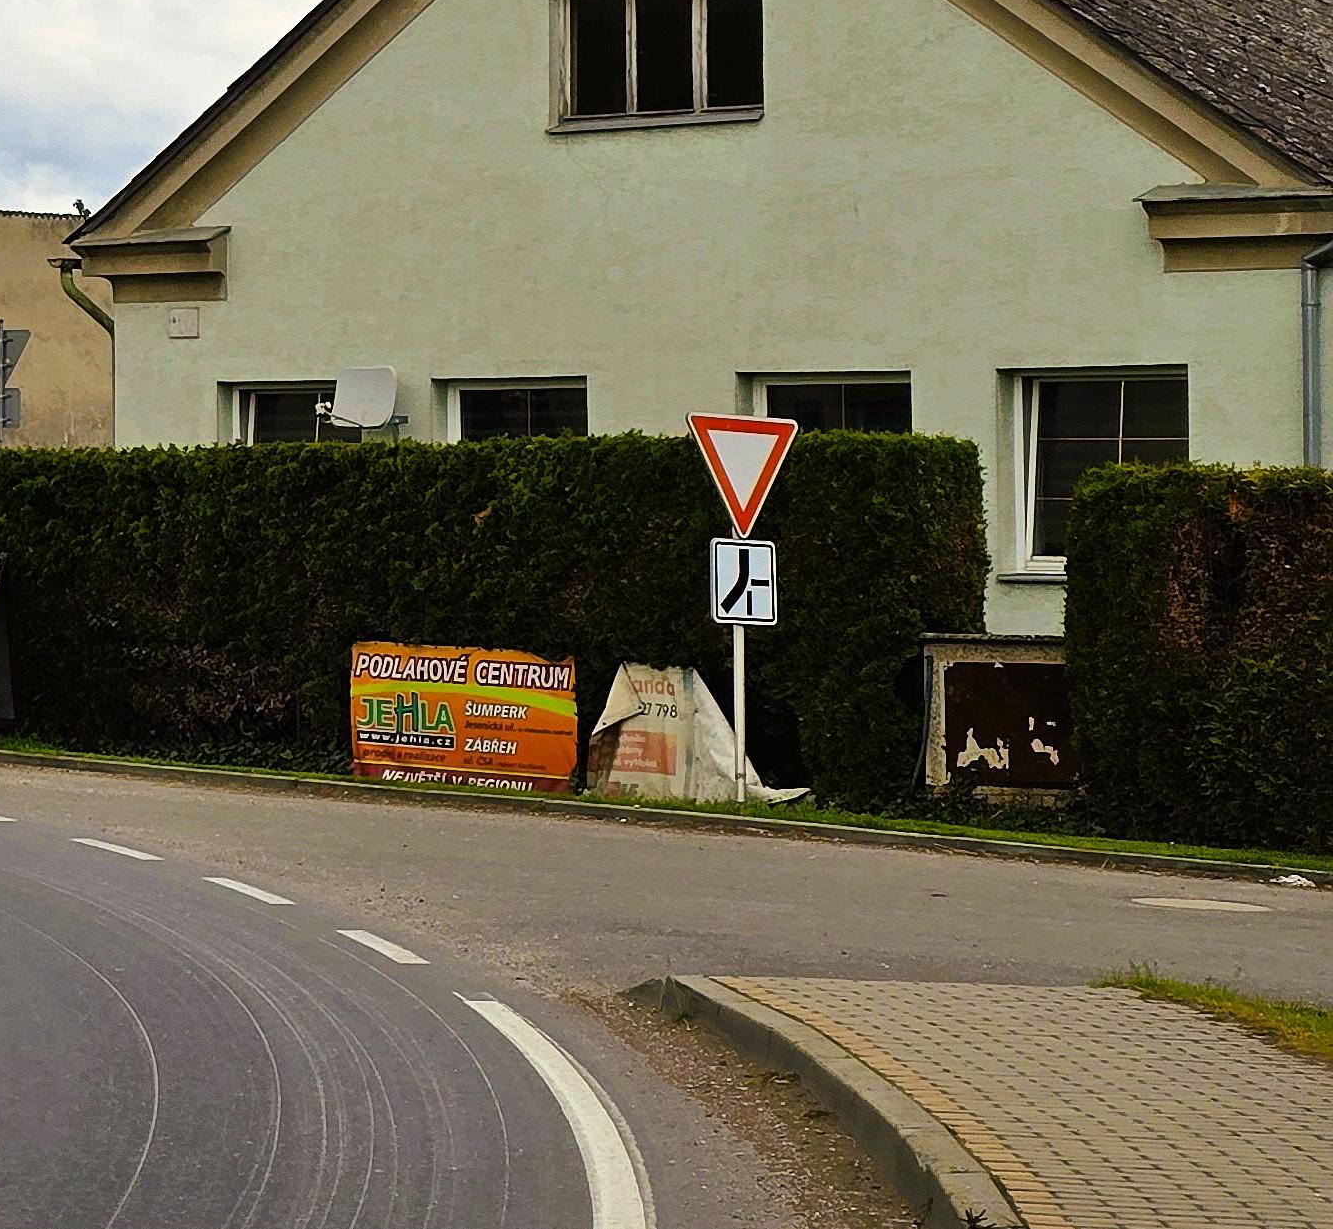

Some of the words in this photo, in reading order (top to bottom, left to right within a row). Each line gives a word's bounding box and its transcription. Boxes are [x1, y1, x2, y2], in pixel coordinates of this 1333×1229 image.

[355, 655, 468, 684] PODLAHOVÉ
[475, 661, 570, 689] CENTRUM
[356, 691, 455, 734] JEHLA
[464, 700, 528, 720] ŠUMPERK
[655, 703, 678, 719] 798
[359, 732, 452, 747] www.jehla.cz
[463, 736, 518, 755] ZÁBŘEH
